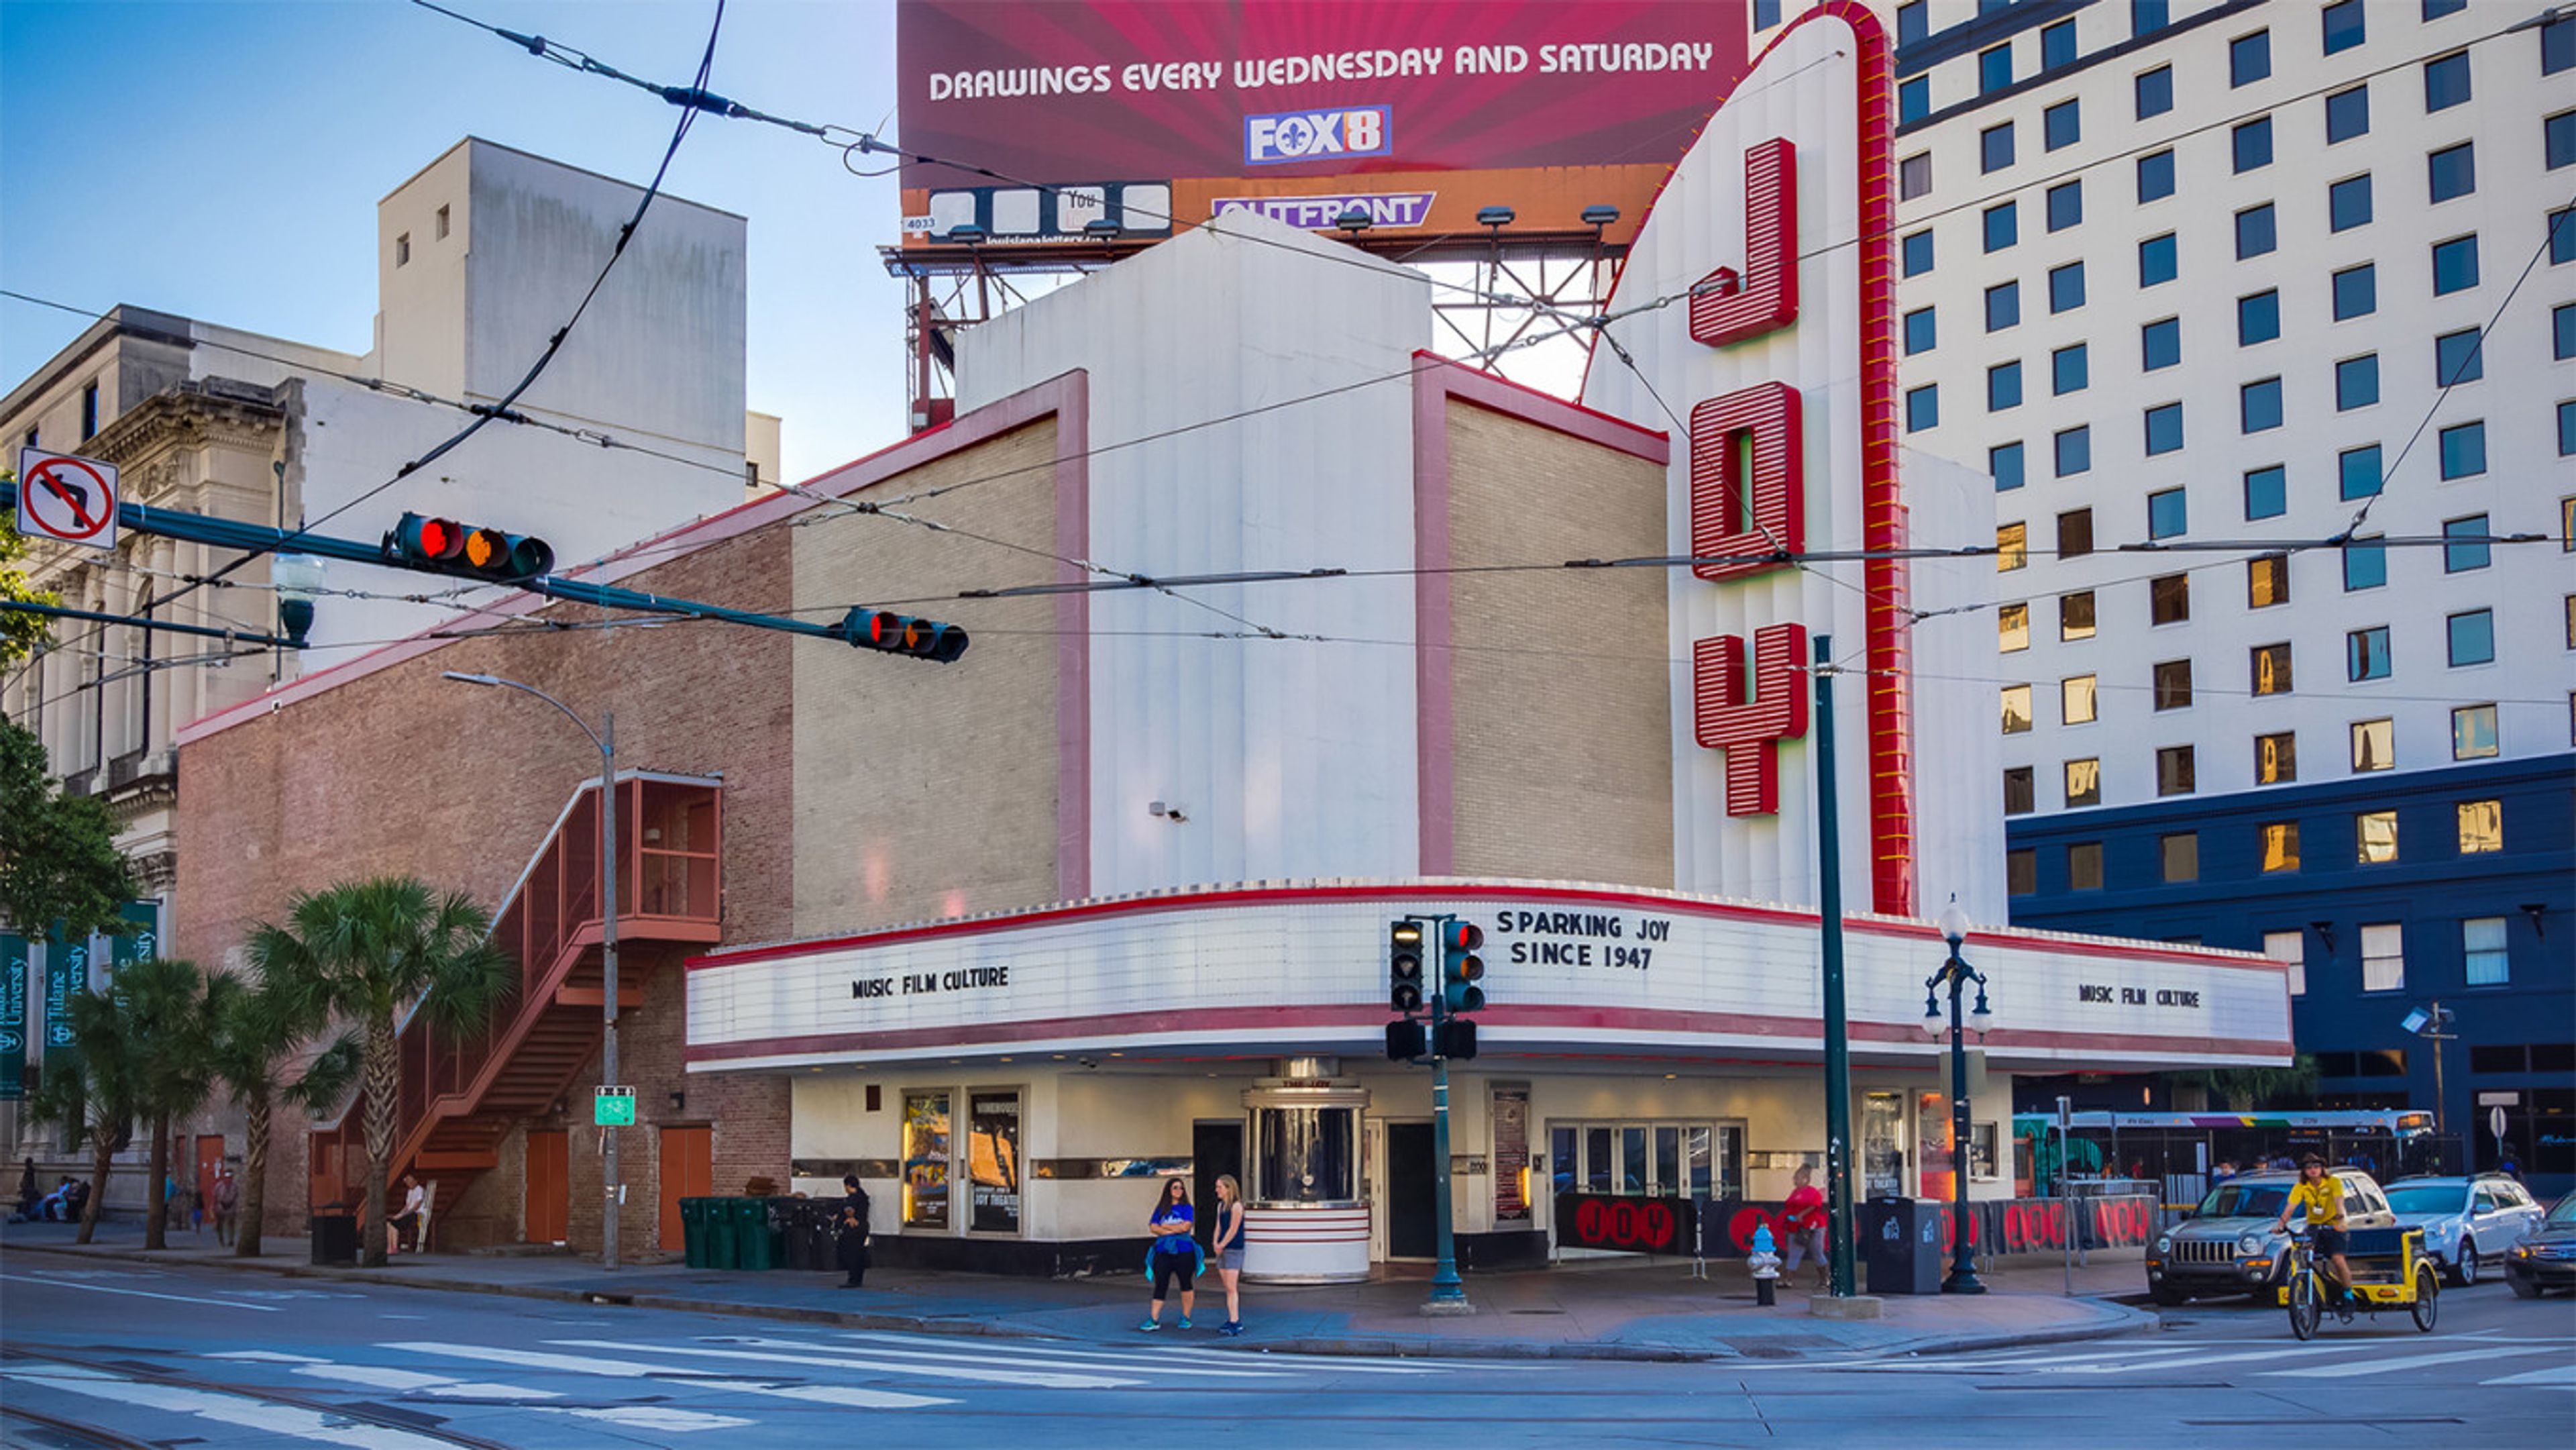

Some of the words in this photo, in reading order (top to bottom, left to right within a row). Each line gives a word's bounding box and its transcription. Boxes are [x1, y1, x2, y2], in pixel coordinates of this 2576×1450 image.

[930, 65, 1111, 100] DRAWINGS
[1122, 61, 1222, 91] EVERY
[1234, 47, 1443, 88] WEDNESDAY
[1455, 45, 1528, 74] AND
[1540, 42, 1713, 72] SATURDAY
[1069, 190, 1095, 208] You
[1221, 197, 1423, 225] TFRONT
[908, 217, 935, 229] 4033
[1497, 911, 1621, 938] SPARKING
[1637, 919, 1670, 942] JOY
[1511, 942, 1591, 966] SINCE
[1605, 945, 1652, 970] 1947
[5, 957, 28, 1025] University
[48, 972, 65, 1020] Tulane
[853, 978, 893, 998] MUSIC
[903, 973, 937, 994] FILM
[943, 966, 1009, 990] CULTURE
[2079, 984, 2113, 1003] MUSIC
[2122, 988, 2147, 1005] FILM
[2156, 990, 2200, 1007] CULTURE
[1586, 1207, 1664, 1242] JOY
[2011, 1206, 2063, 1236] JOY
